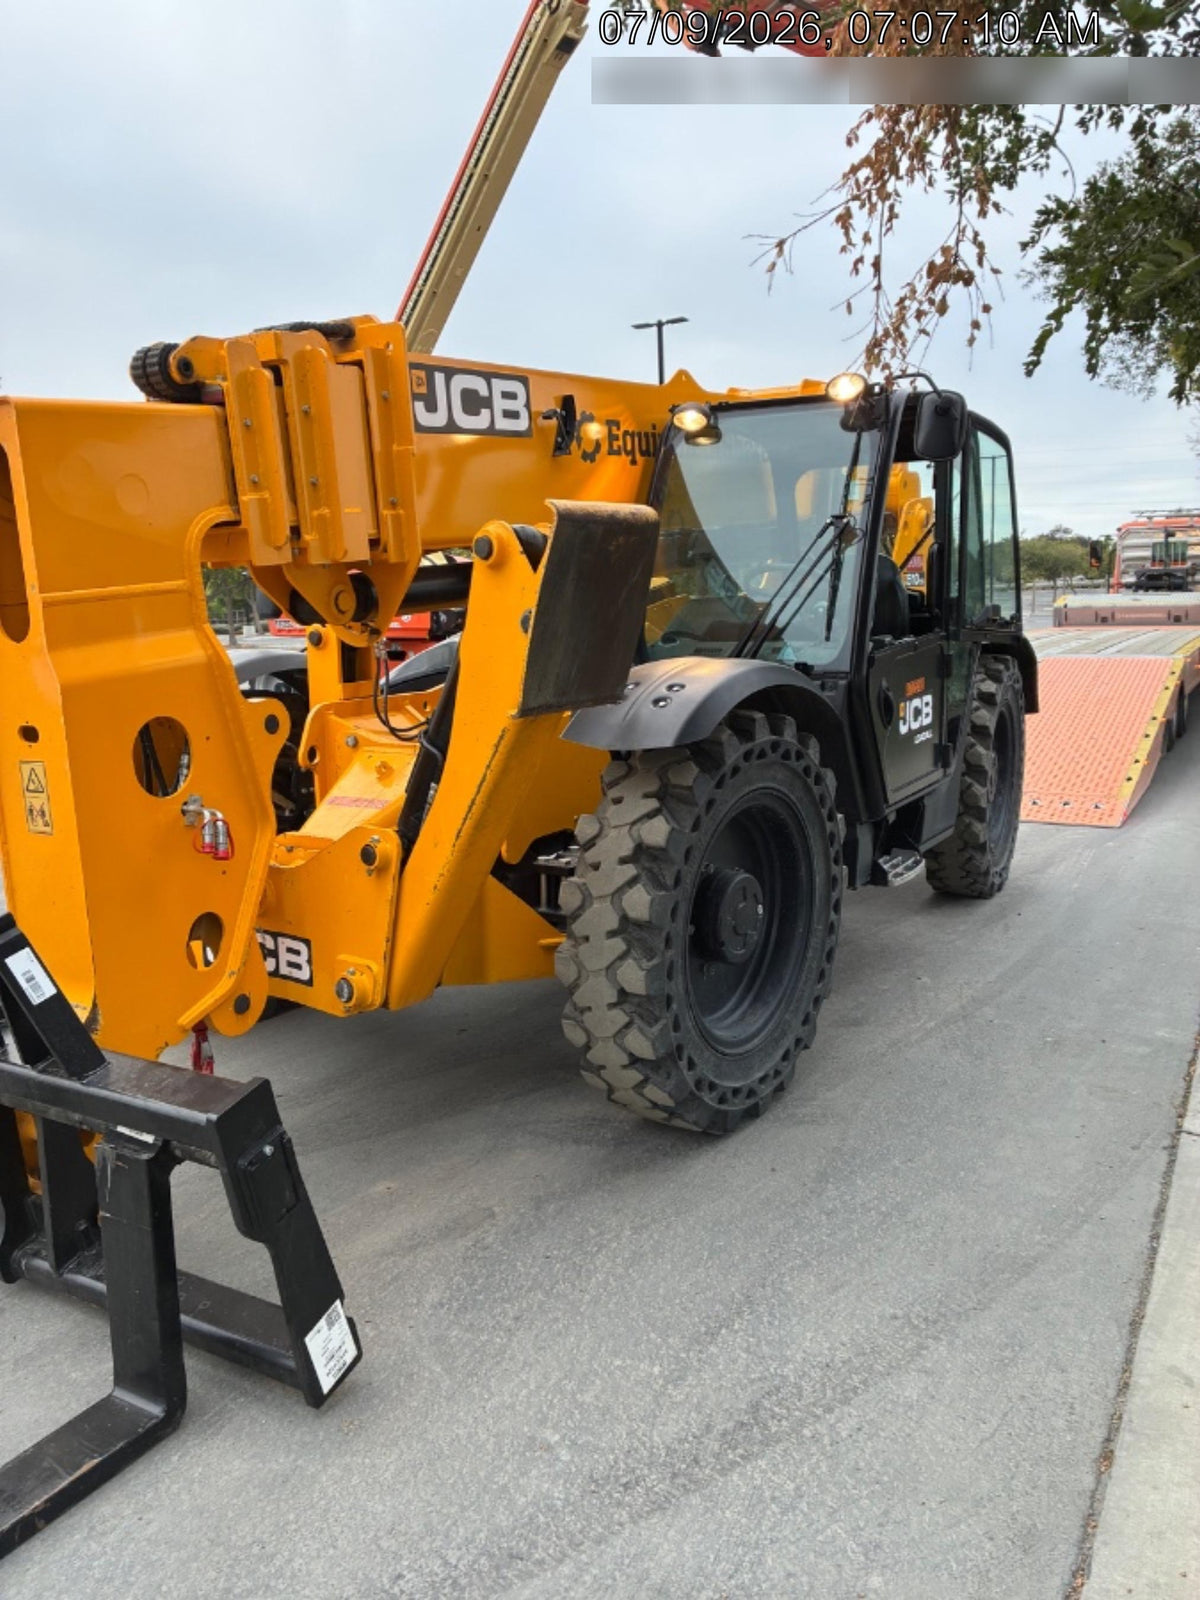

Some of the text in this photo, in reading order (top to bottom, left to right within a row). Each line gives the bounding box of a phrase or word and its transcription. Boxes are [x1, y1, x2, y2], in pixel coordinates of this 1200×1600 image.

[414, 371, 529, 431] JCB
[606, 419, 660, 466] Equi
[899, 694, 933, 735] JCB
[256, 932, 311, 981] CB
